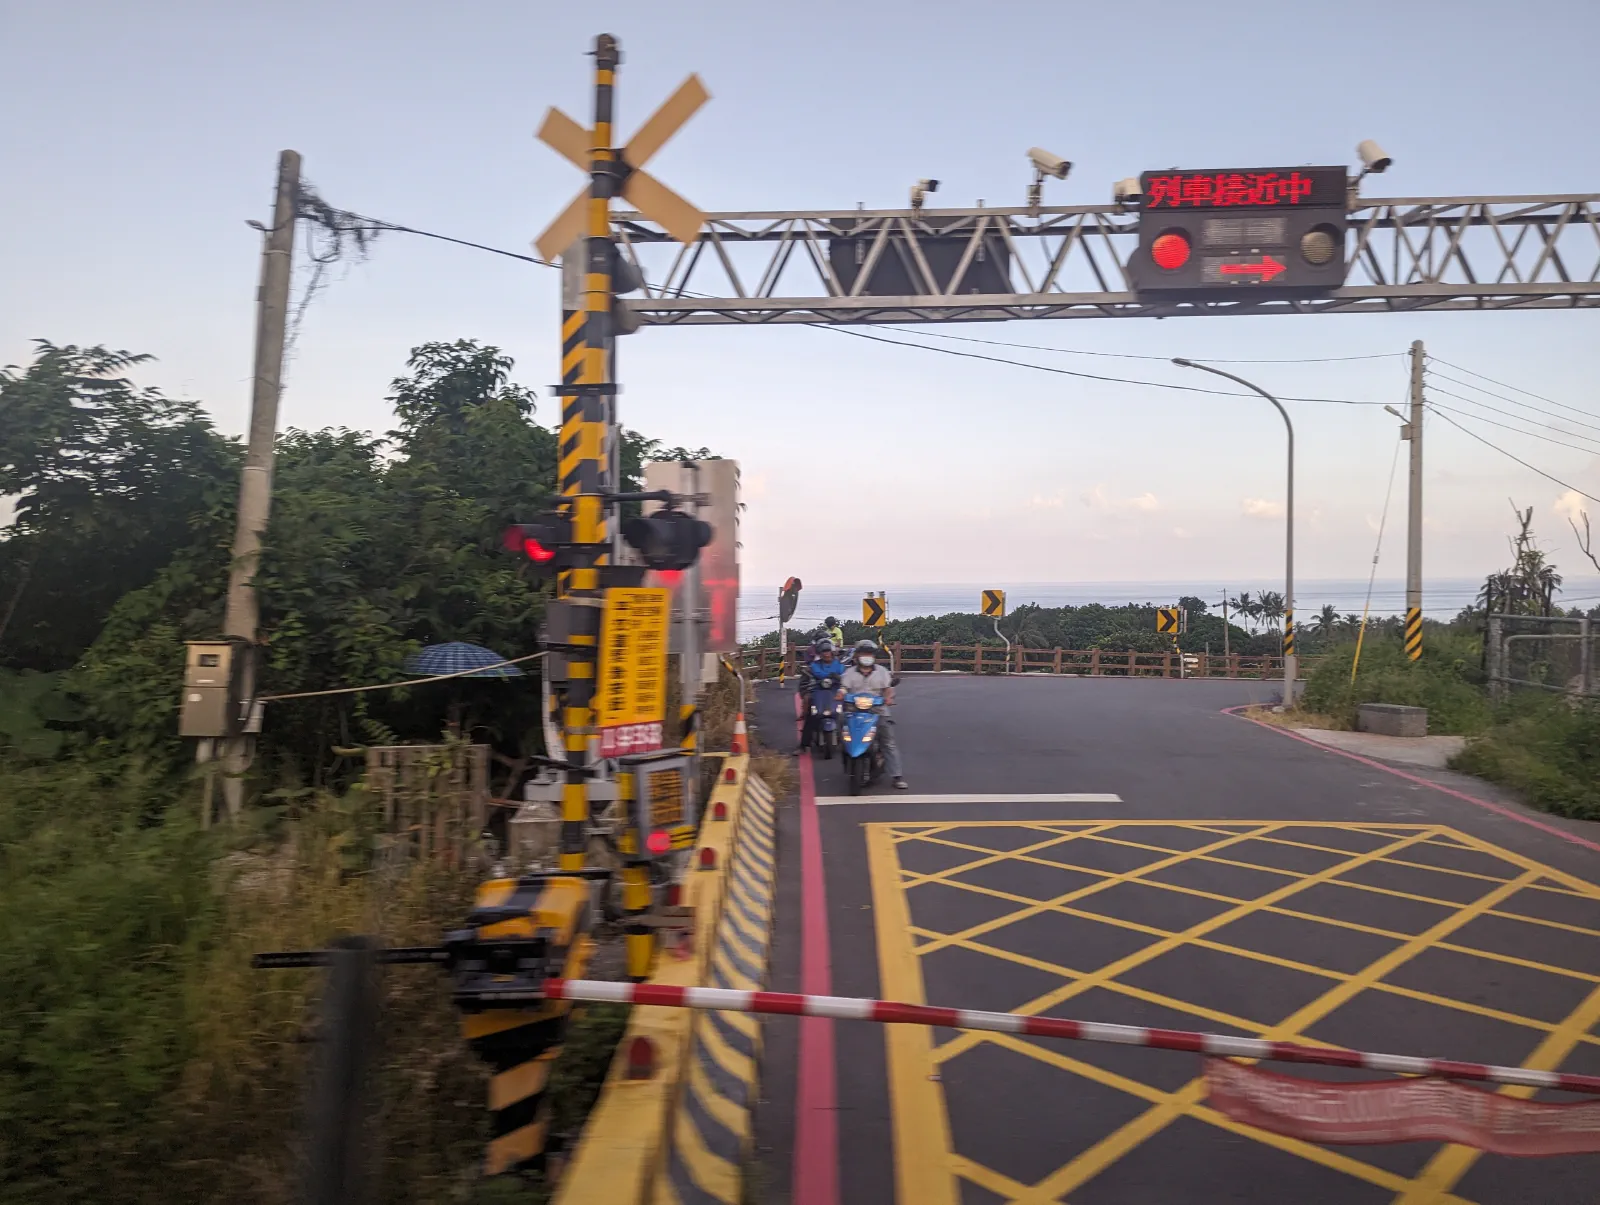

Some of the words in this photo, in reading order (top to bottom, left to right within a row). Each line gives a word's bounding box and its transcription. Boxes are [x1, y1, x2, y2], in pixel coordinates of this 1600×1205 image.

[1147, 172, 1313, 207] 列車接近中
